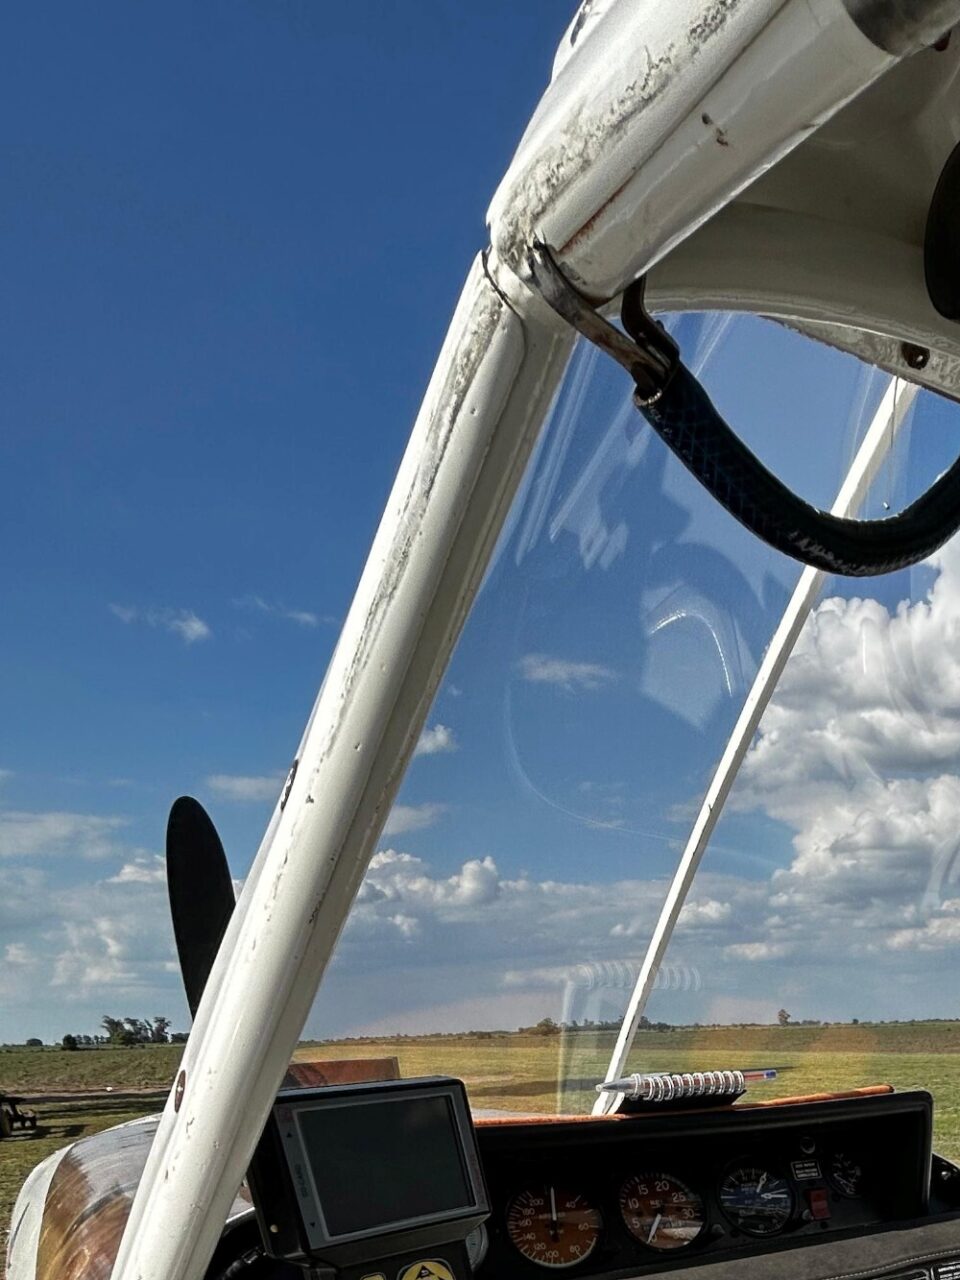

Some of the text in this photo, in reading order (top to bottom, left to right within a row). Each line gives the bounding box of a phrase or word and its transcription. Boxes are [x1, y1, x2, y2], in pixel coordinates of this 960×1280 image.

[638, 1184, 648, 1195] 15
[654, 1180, 670, 1192] 20
[671, 1192, 686, 1203] 25
[565, 1201, 576, 1209] 40
[628, 1198, 639, 1209] 10
[680, 1208, 695, 1219] 30
[578, 1223, 589, 1231] 60
[632, 1218, 641, 1228] 5
[523, 1232, 536, 1240] 140
[534, 1242, 547, 1250] 120
[569, 1245, 580, 1253] 80
[545, 1250, 560, 1258] 100
